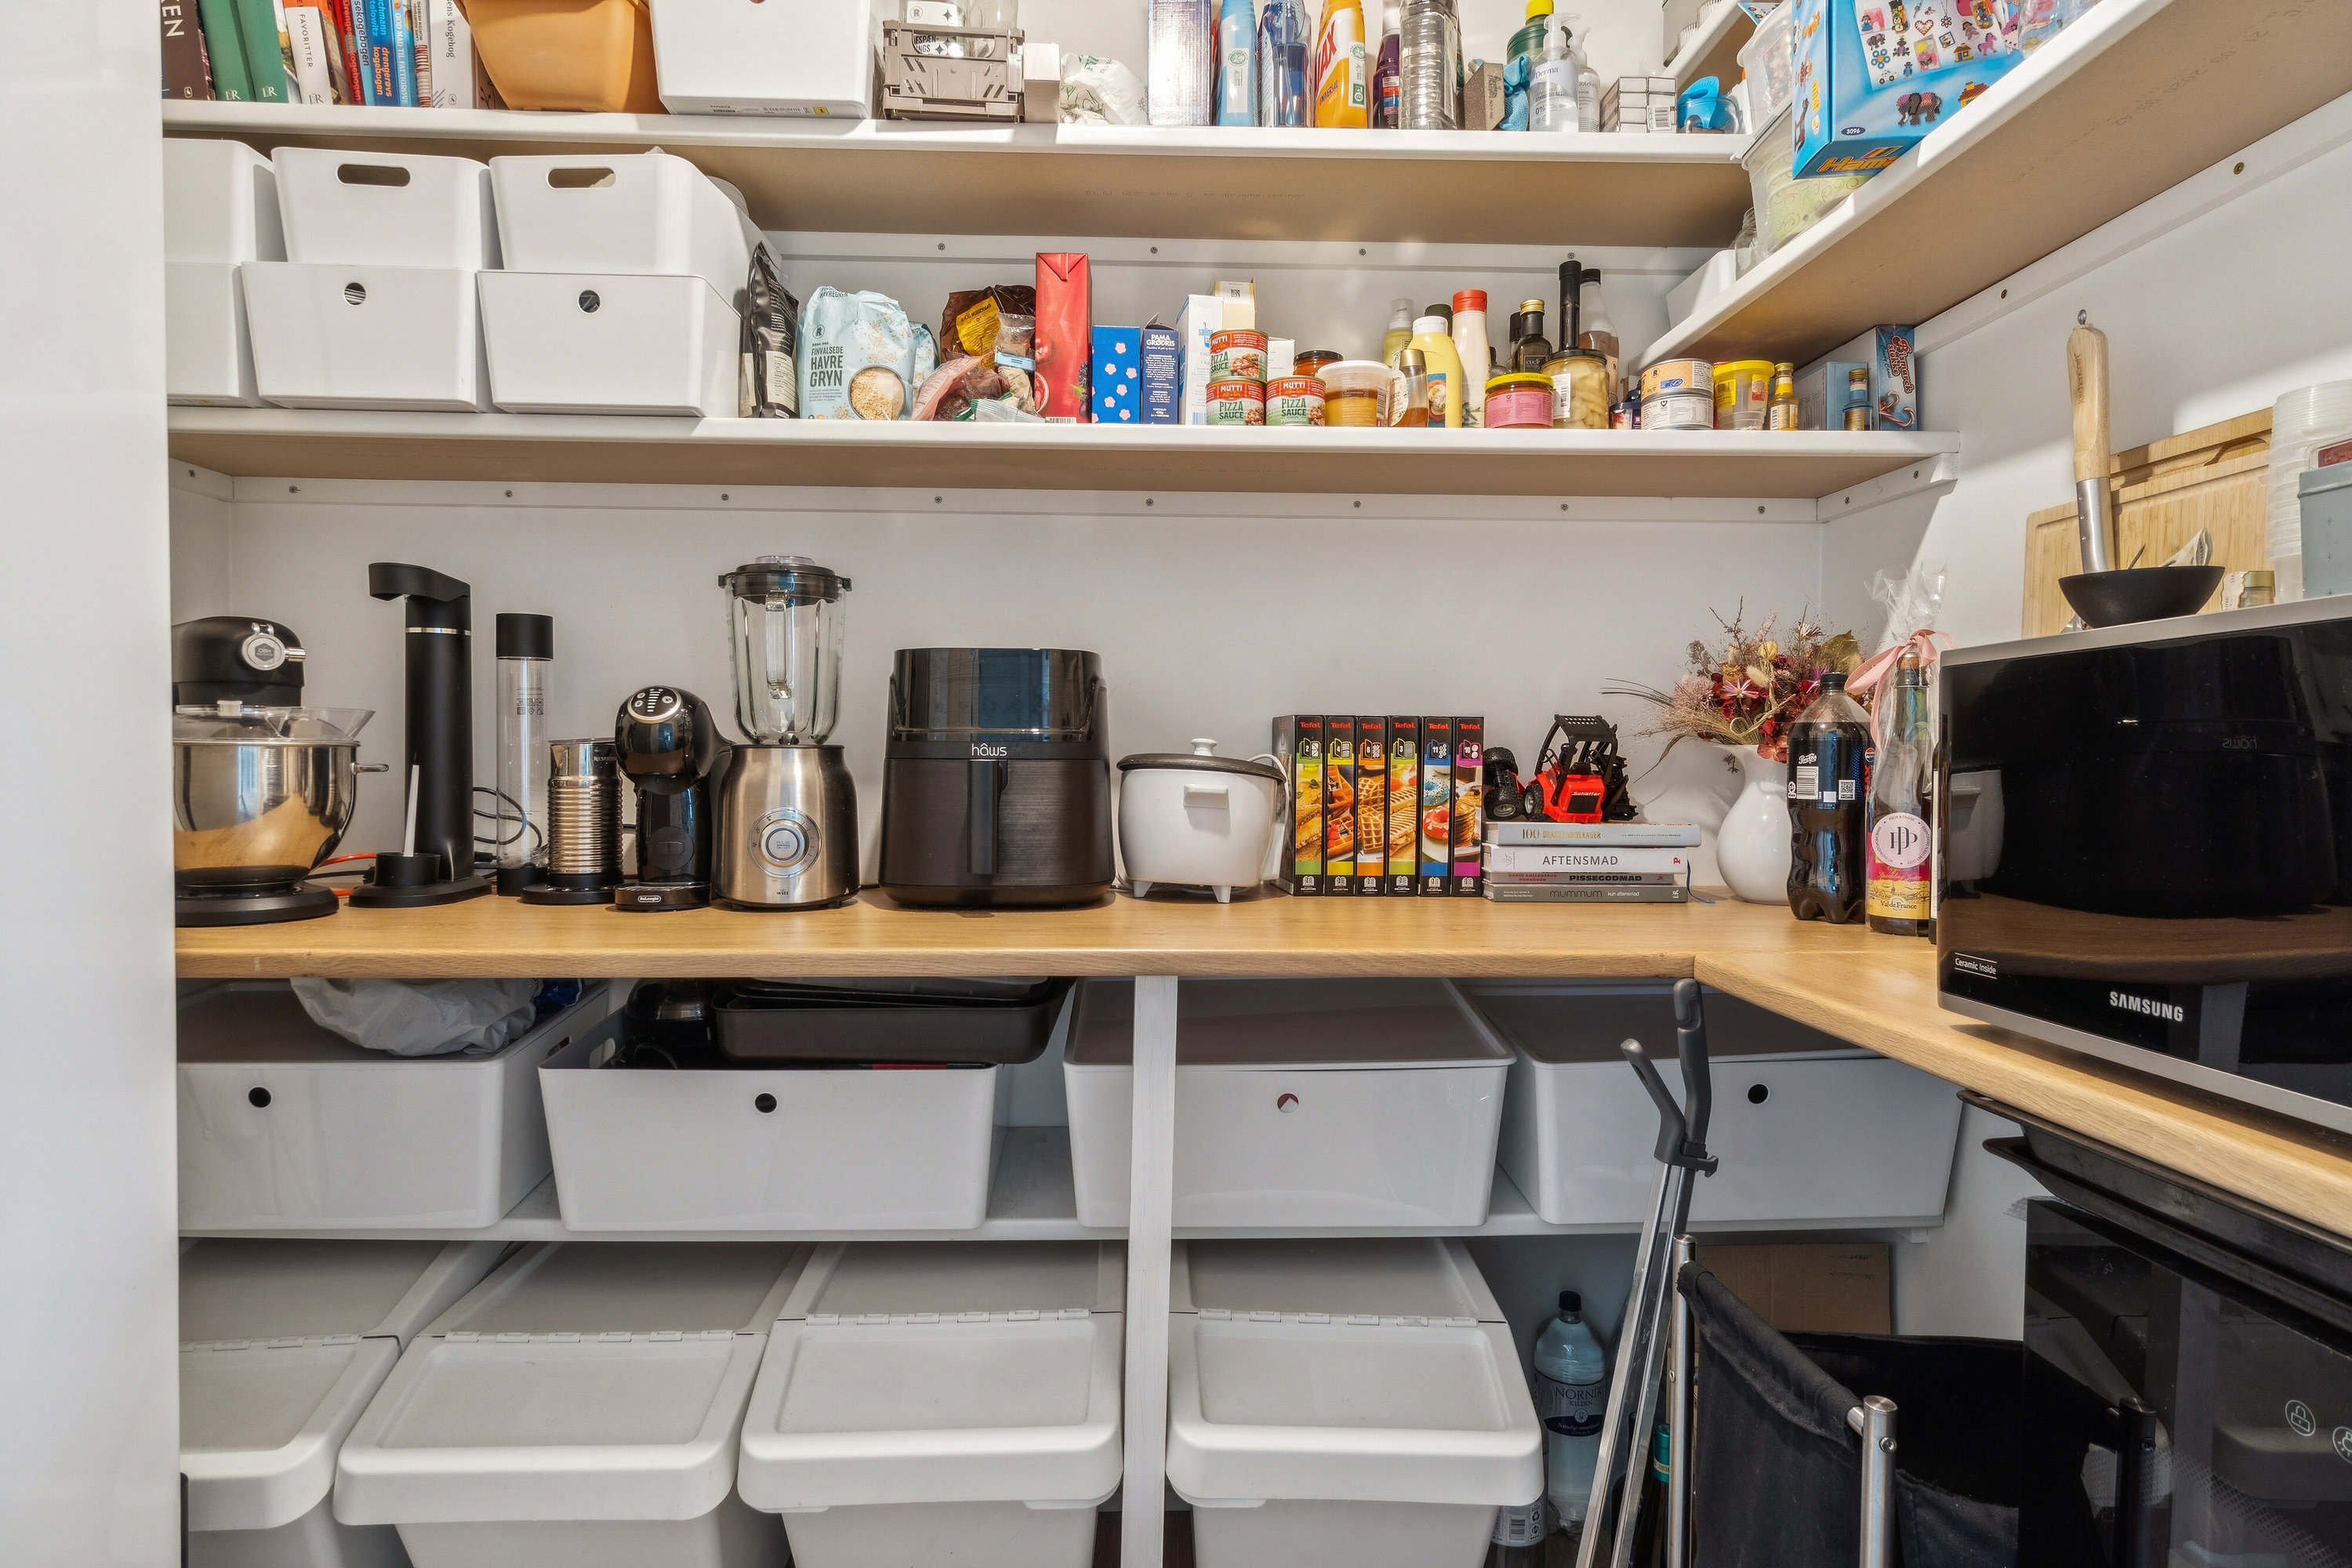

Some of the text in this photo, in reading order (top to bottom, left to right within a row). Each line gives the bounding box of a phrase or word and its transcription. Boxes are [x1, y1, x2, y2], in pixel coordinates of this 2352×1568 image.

[299, 13, 313, 67] FAVORITTER
[395, 31, 404, 47] MAD
[445, 20, 456, 58] Kogebog
[397, 48, 405, 60] TIL
[416, 45, 430, 72] KYLLING
[372, 46, 383, 96] kogebogen
[381, 47, 392, 97] drengerøvs
[1536, 67, 1559, 79] Derma
[1319, 79, 1338, 105] UNIVERSAL
[1211, 335, 1228, 345] MUTTI
[811, 346, 843, 355] FINVALSEDE
[1210, 351, 1229, 365] PIZZA
[811, 355, 843, 371] HAVRE
[1210, 361, 1229, 373] SAUCE
[1887, 343, 1900, 376] stokke
[1891, 335, 1915, 394] Bismarck
[810, 370, 843, 387] GRYN
[1221, 383, 1243, 392] MUTTI
[1219, 401, 1243, 412] PIZZA
[1282, 397, 1306, 408] PIZZA
[1219, 411, 1244, 420] SAUCE
[1281, 408, 1306, 417] SAUCE
[971, 742, 1007, 757] hâws
[1523, 829, 1540, 839] 100
[1542, 855, 1618, 866] AFTENSMAD
[1955, 957, 1996, 975] Ceramic Inside
[2109, 991, 2183, 1022] SAMSUNG
[1555, 1385, 1602, 1400] NORNIR
